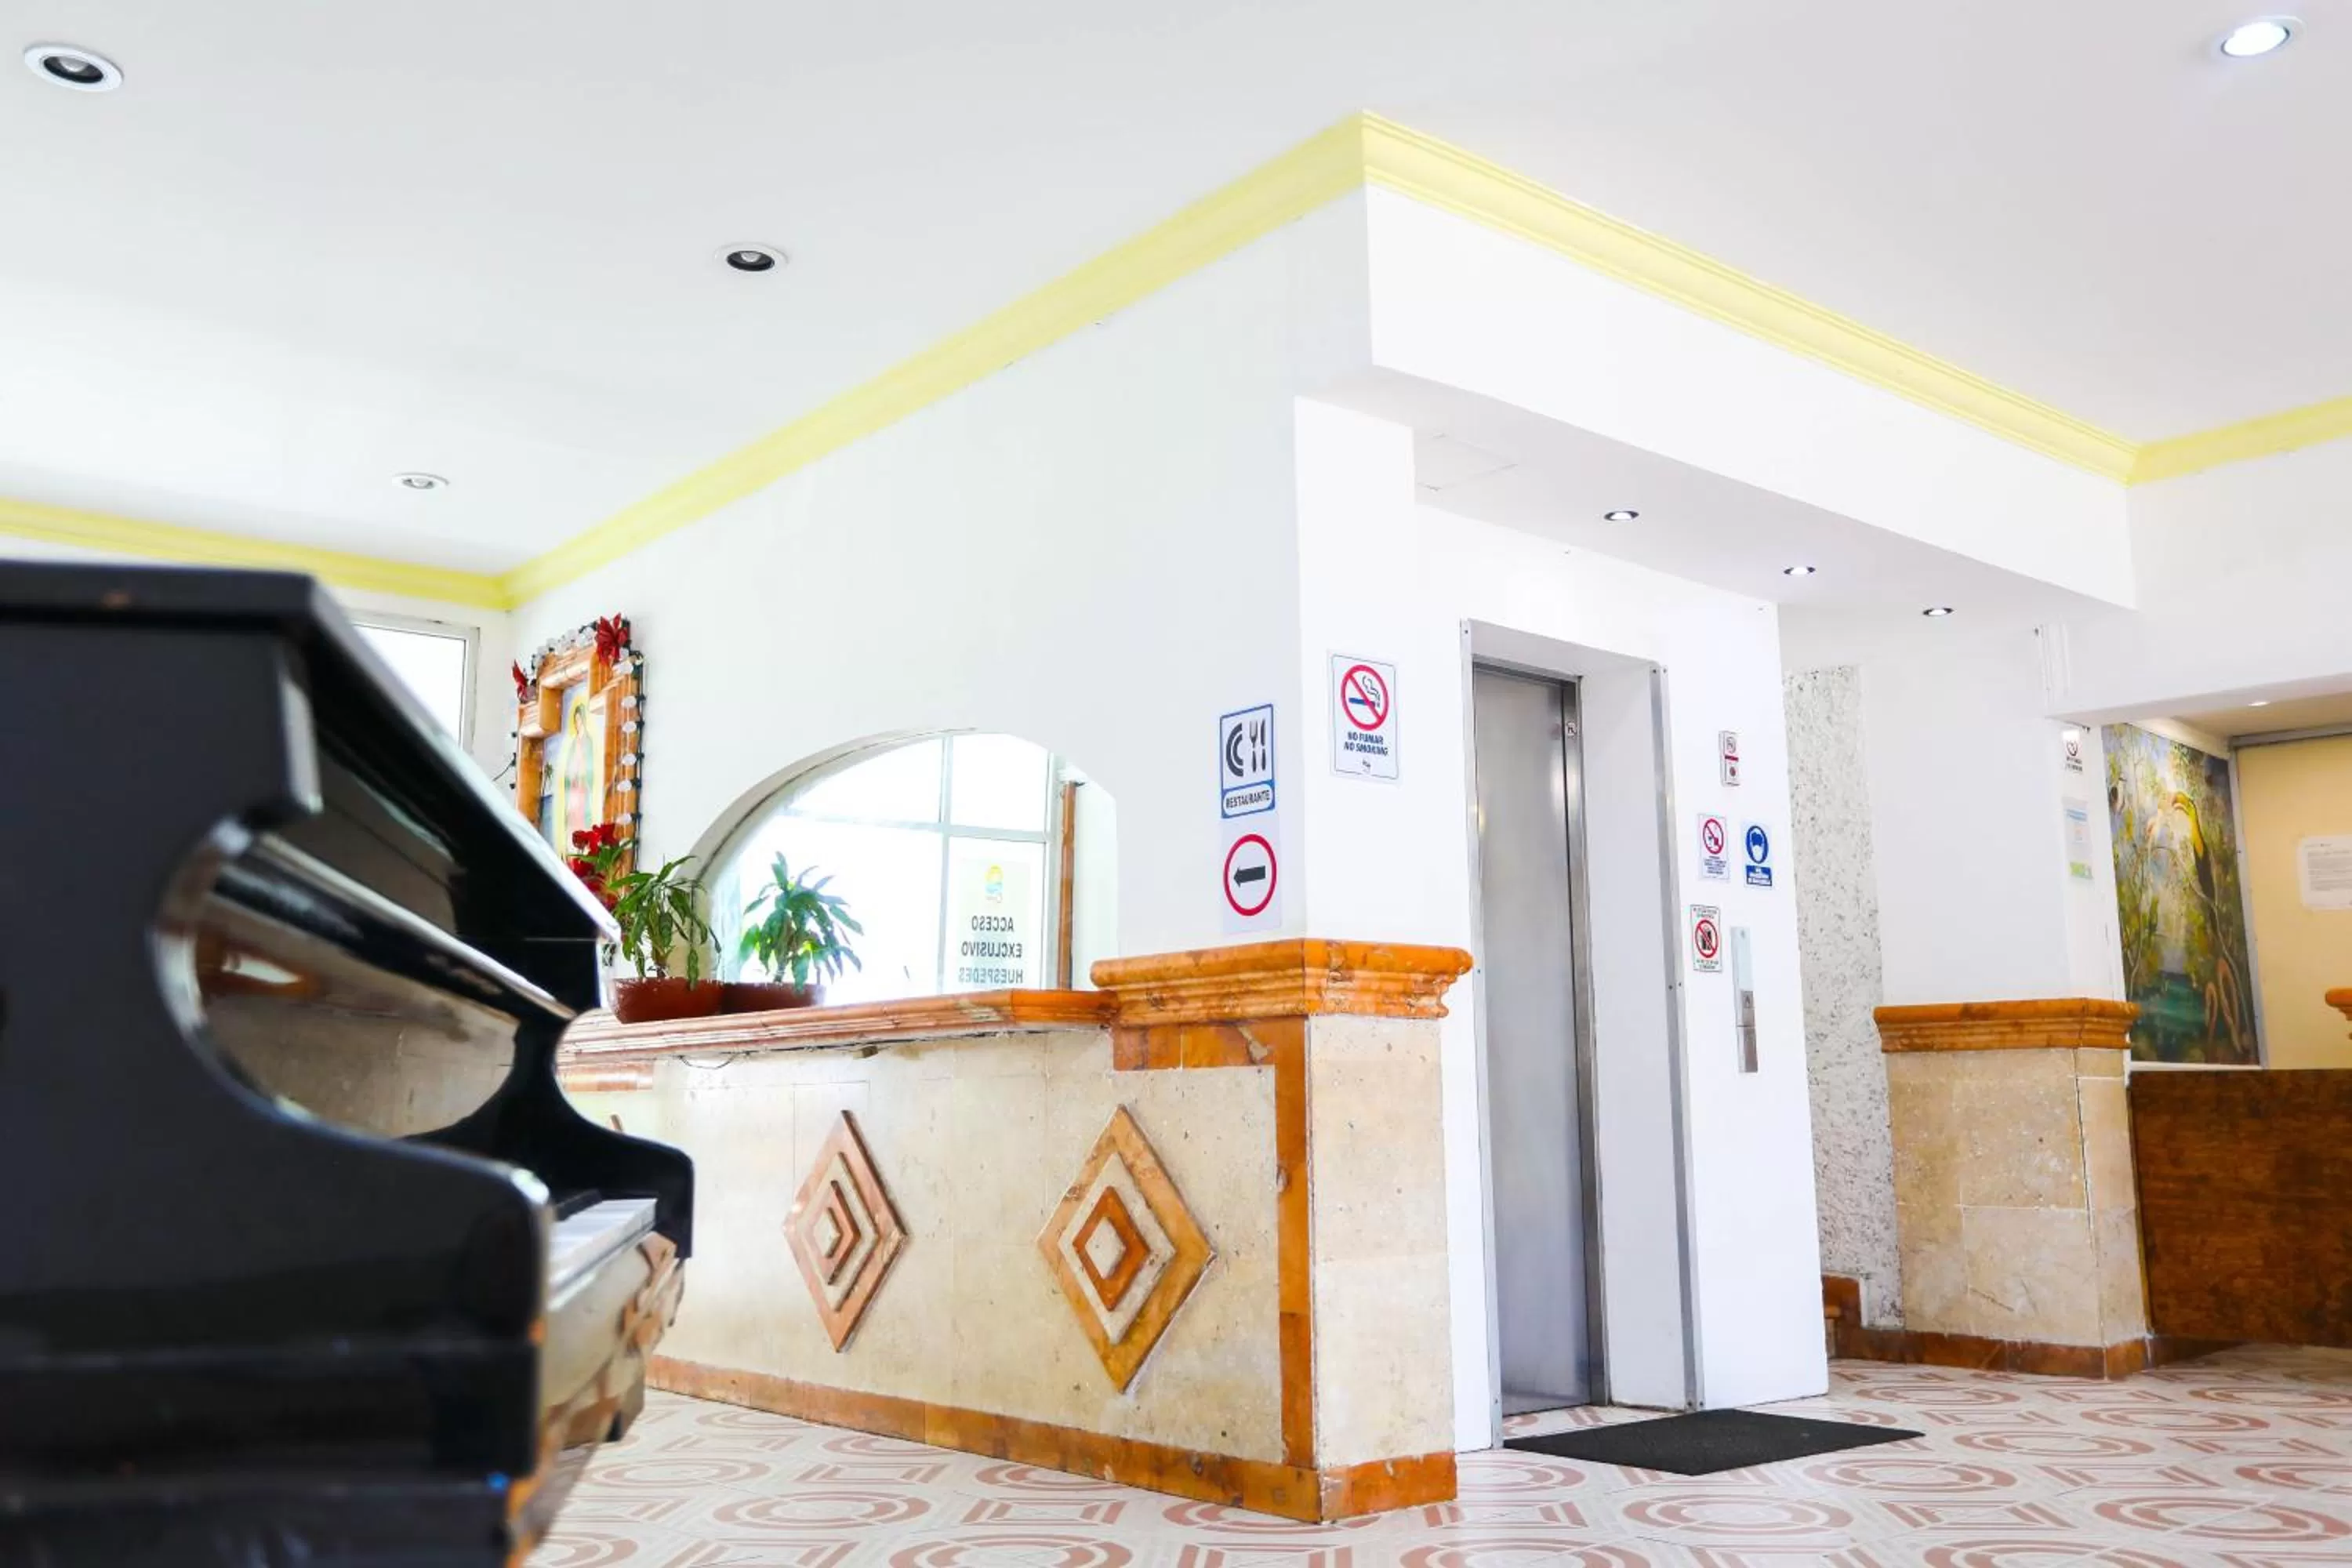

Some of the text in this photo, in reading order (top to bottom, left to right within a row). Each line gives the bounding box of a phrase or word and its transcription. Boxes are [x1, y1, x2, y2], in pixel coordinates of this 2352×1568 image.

[1347, 731, 1358, 741] NO
[1344, 741, 1356, 751] NO
[1225, 789, 1270, 809] RESTAURANTE
